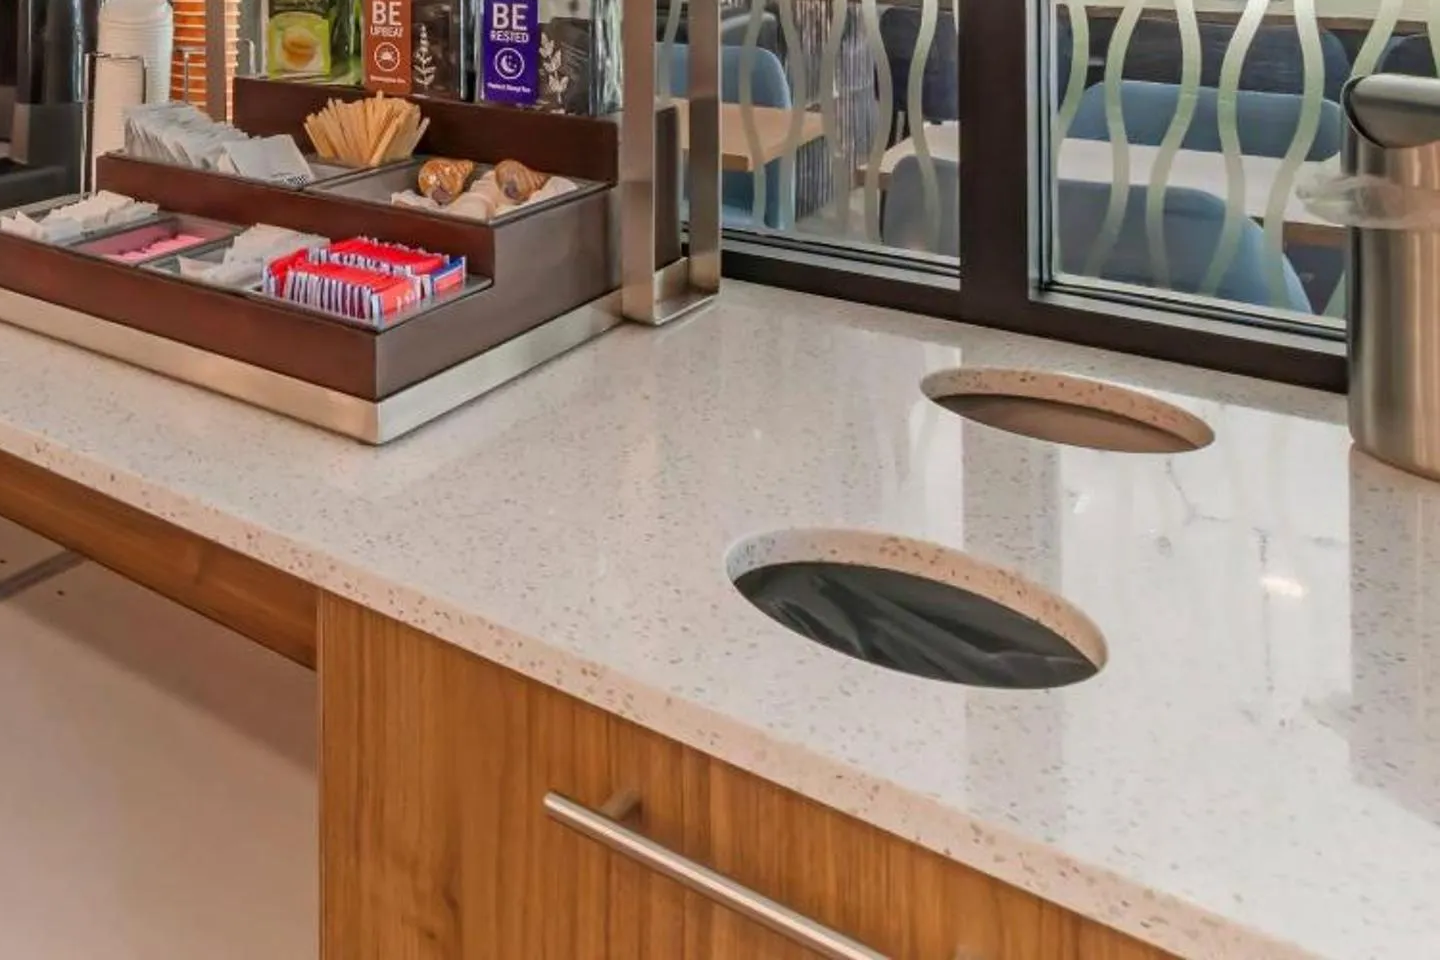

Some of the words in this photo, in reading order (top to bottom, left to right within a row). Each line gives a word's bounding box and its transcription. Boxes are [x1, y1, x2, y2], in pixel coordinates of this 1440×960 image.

[371, 0, 402, 26] BE
[492, 2, 528, 31] BE
[489, 29, 530, 43] RESTED
